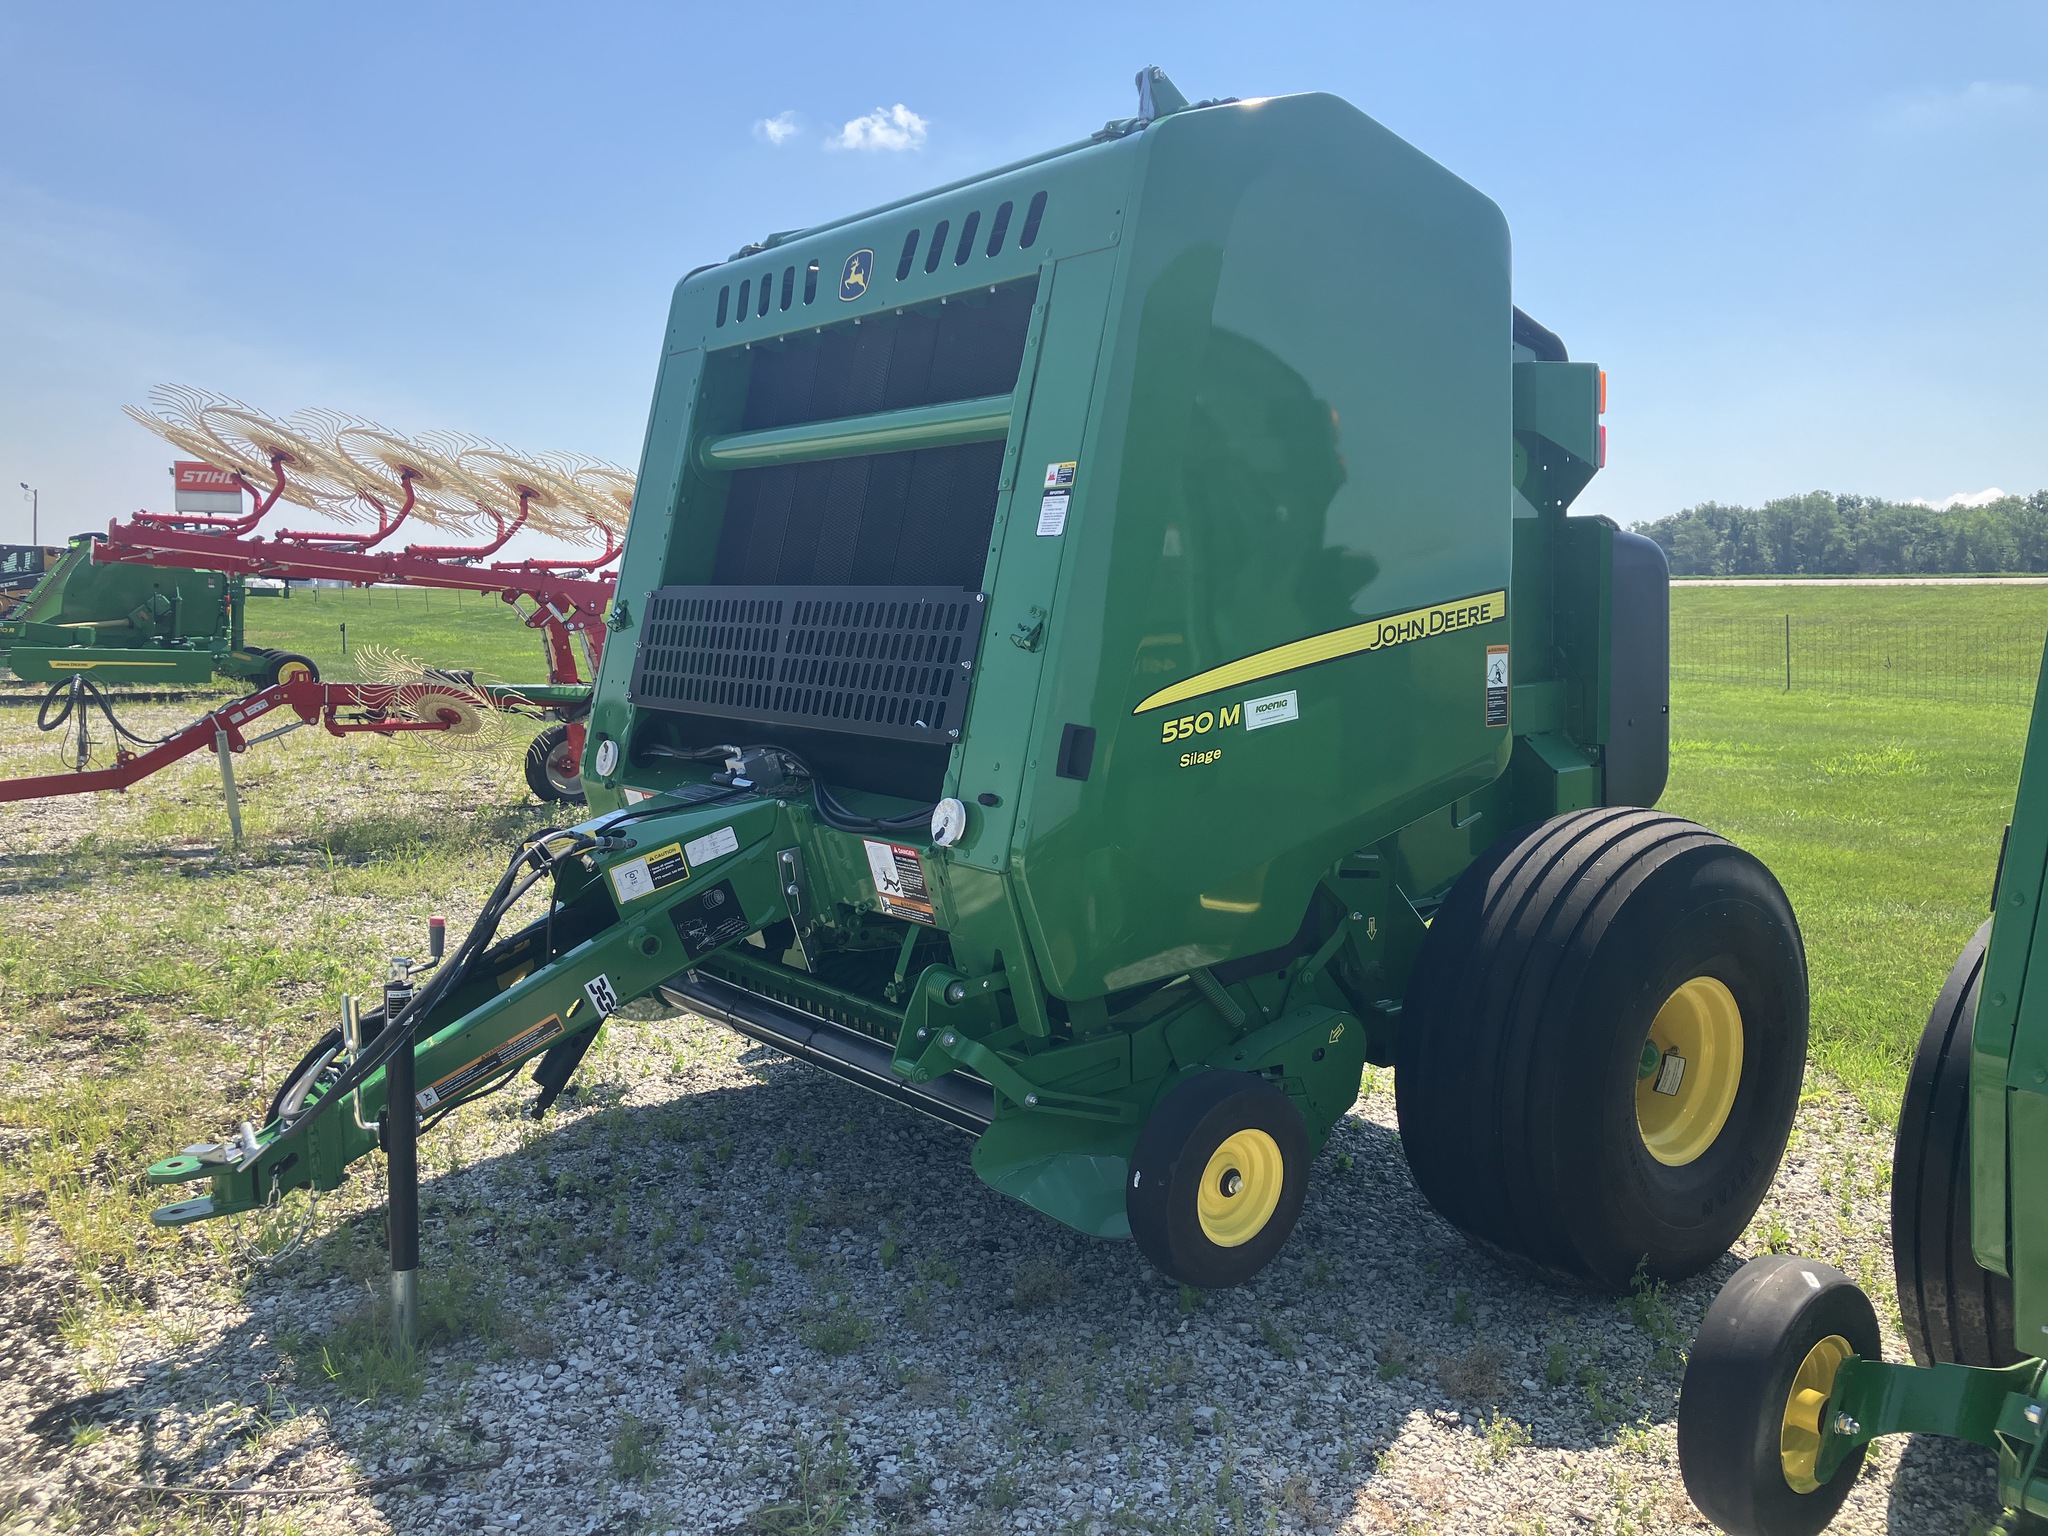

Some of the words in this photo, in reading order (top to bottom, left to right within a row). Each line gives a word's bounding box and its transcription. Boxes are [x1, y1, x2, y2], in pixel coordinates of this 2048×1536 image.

[181, 470, 234, 484] STIHL
[1370, 617, 1425, 648] JOHN
[1429, 602, 1492, 633] DEERE
[1161, 711, 1214, 744] 550
[1218, 702, 1241, 729] M
[1179, 748, 1222, 768] Silage
[654, 847, 677, 860] CAUTION
[485, 1042, 509, 1059] WARNING
